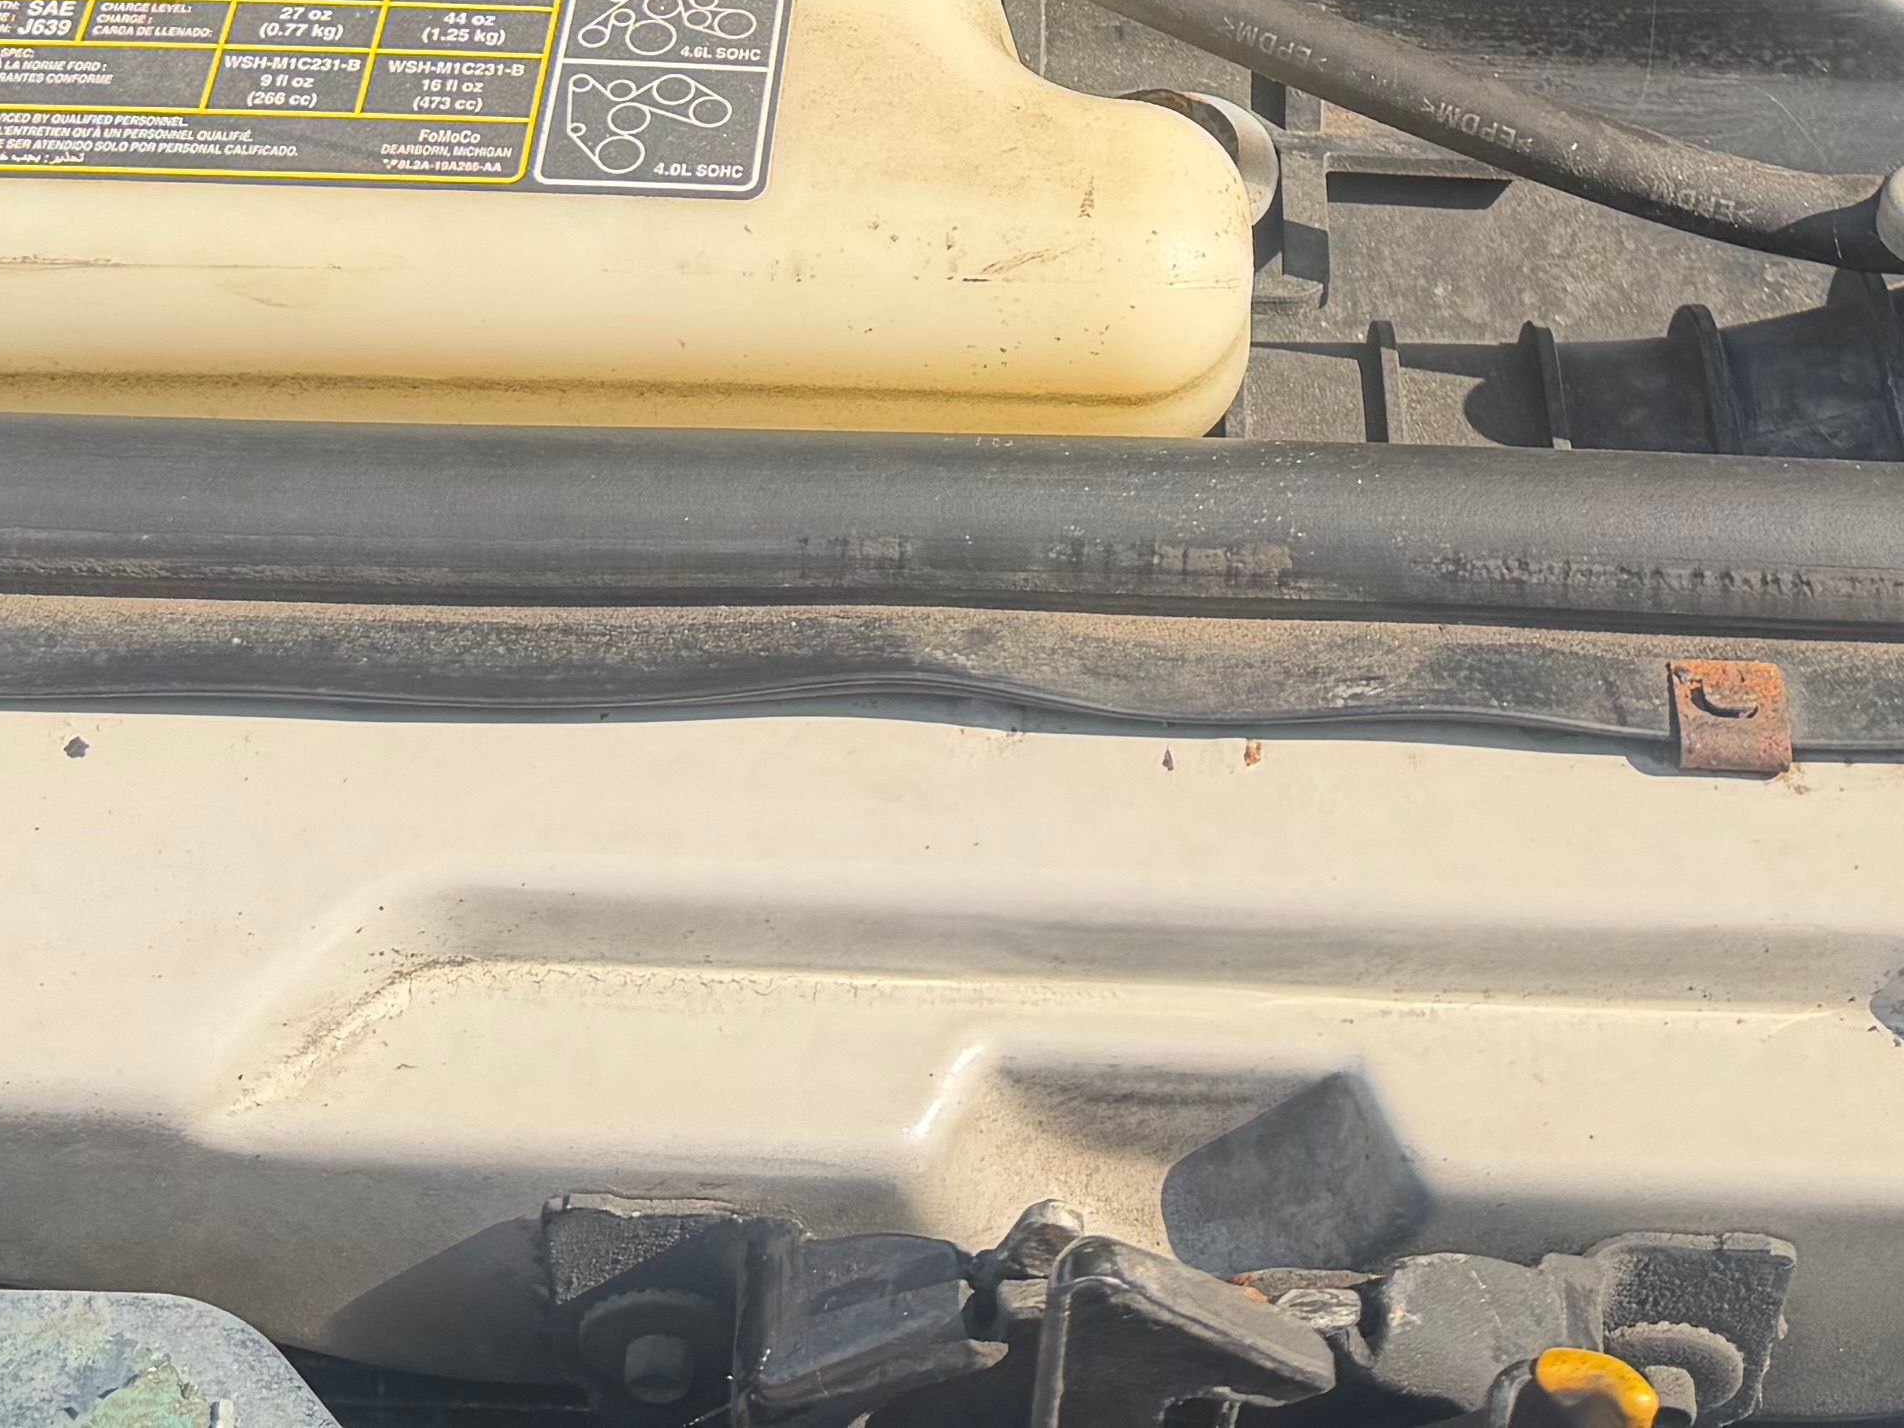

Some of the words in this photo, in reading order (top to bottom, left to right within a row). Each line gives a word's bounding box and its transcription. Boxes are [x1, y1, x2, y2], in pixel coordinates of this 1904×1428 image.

[26, 0, 76, 16] SAE
[279, 7, 303, 20] 27
[307, 8, 332, 20] oz
[443, 12, 467, 25] 44
[471, 13, 495, 25] oz
[16, 19, 72, 35] J639
[257, 22, 307, 39] (0.77
[309, 24, 344, 40] kg)
[420, 27, 470, 44] (1.25
[472, 29, 506, 45] kg)
[679, 46, 713, 59] 4.6L
[714, 47, 761, 61] SOHC
[223, 56, 362, 72] WSH-M1C231-B
[386, 60, 526, 76] WSH-M1C231-B
[259, 75, 272, 86] 9
[274, 75, 288, 87] fl
[290, 76, 314, 88] oz
[420, 79, 441, 91] 16
[444, 80, 458, 92] fl
[461, 80, 483, 92] oz
[244, 91, 286, 107] (266
[287, 93, 318, 108] cc)
[410, 96, 451, 112] (473
[453, 97, 483, 112] cc)
[416, 129, 482, 143] FoMoCo
[379, 144, 451, 156] DEARBORN,
[452, 146, 512, 158] MICHIGAN
[652, 163, 694, 176] 4.0L
[694, 164, 744, 177] SOHC
